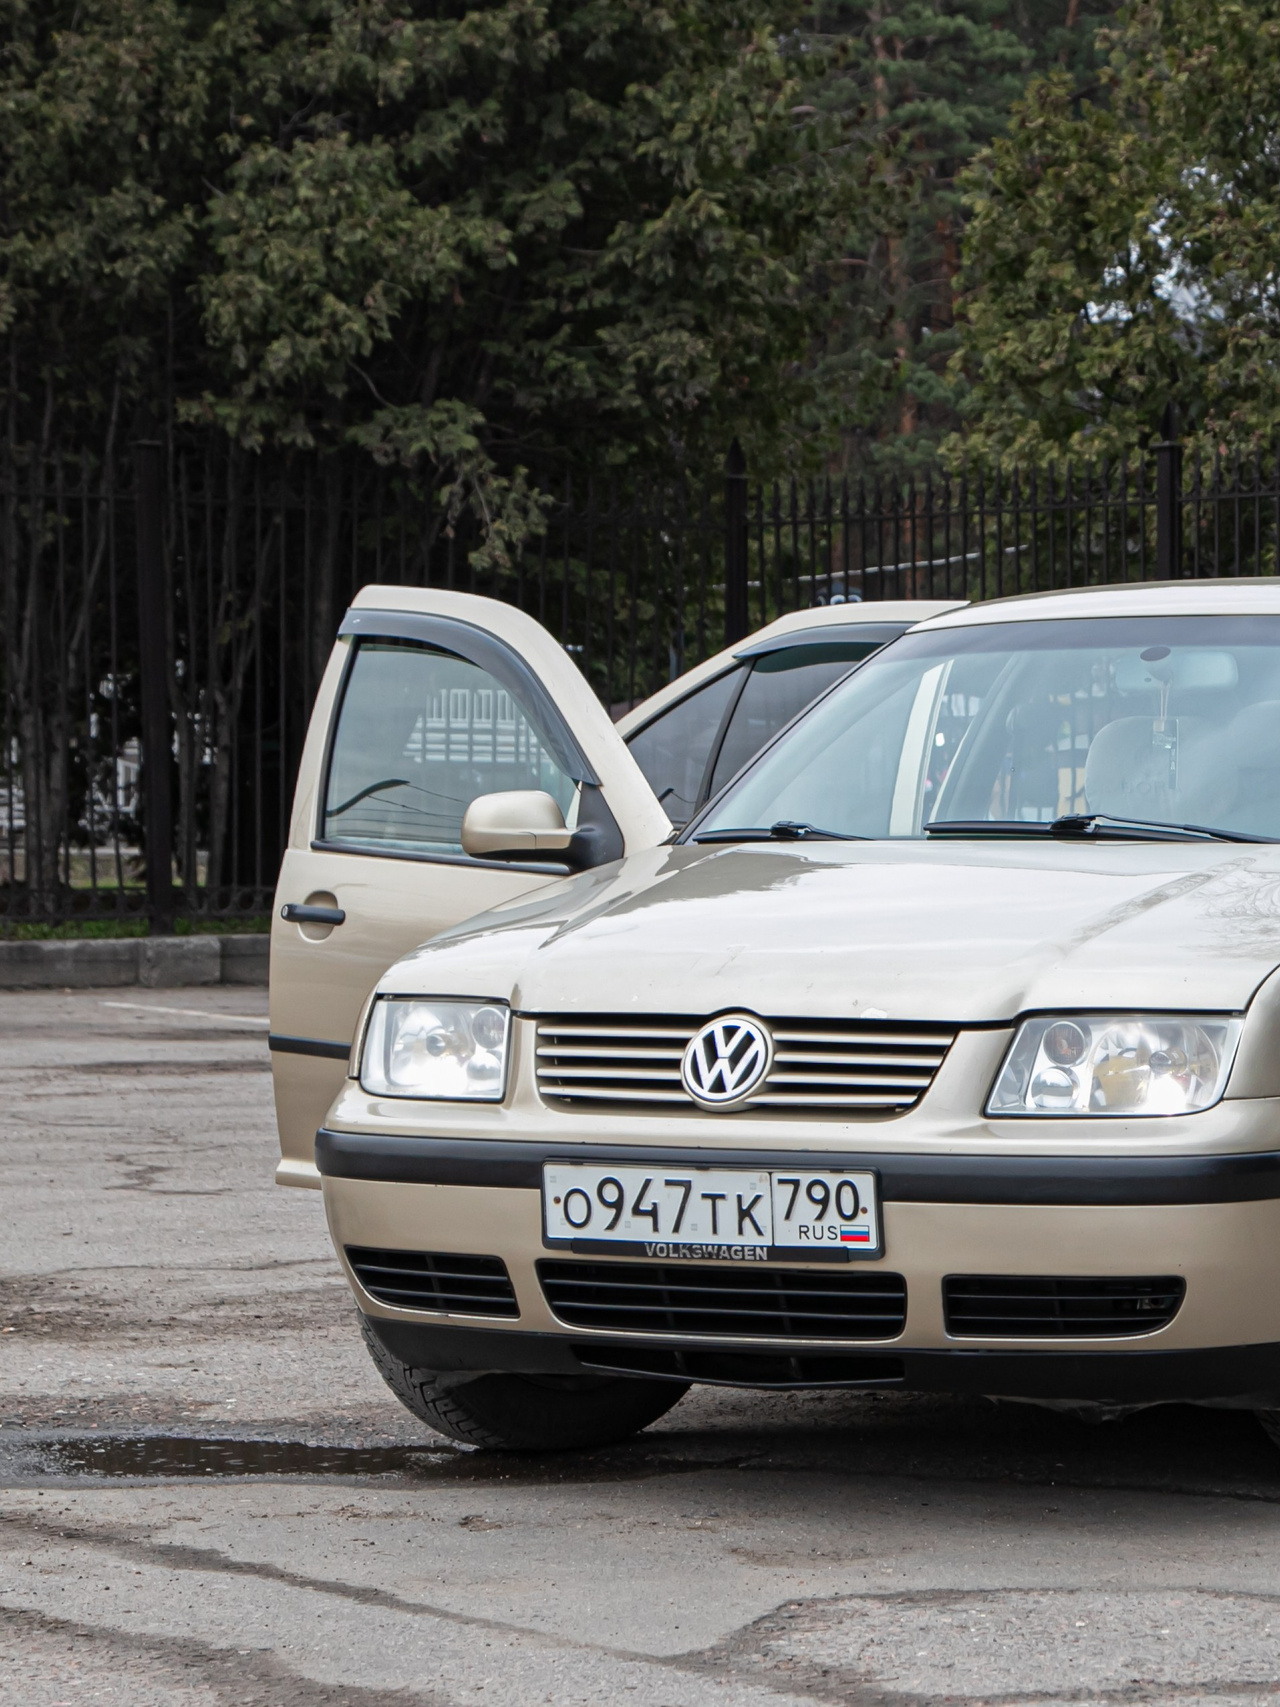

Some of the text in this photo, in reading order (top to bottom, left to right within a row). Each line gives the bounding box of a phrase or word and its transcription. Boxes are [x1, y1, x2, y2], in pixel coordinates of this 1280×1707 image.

[776, 1177, 861, 1222] 790
[798, 1224, 839, 1241] RUS
[644, 1242, 768, 1261] VOLKSWAGEN
